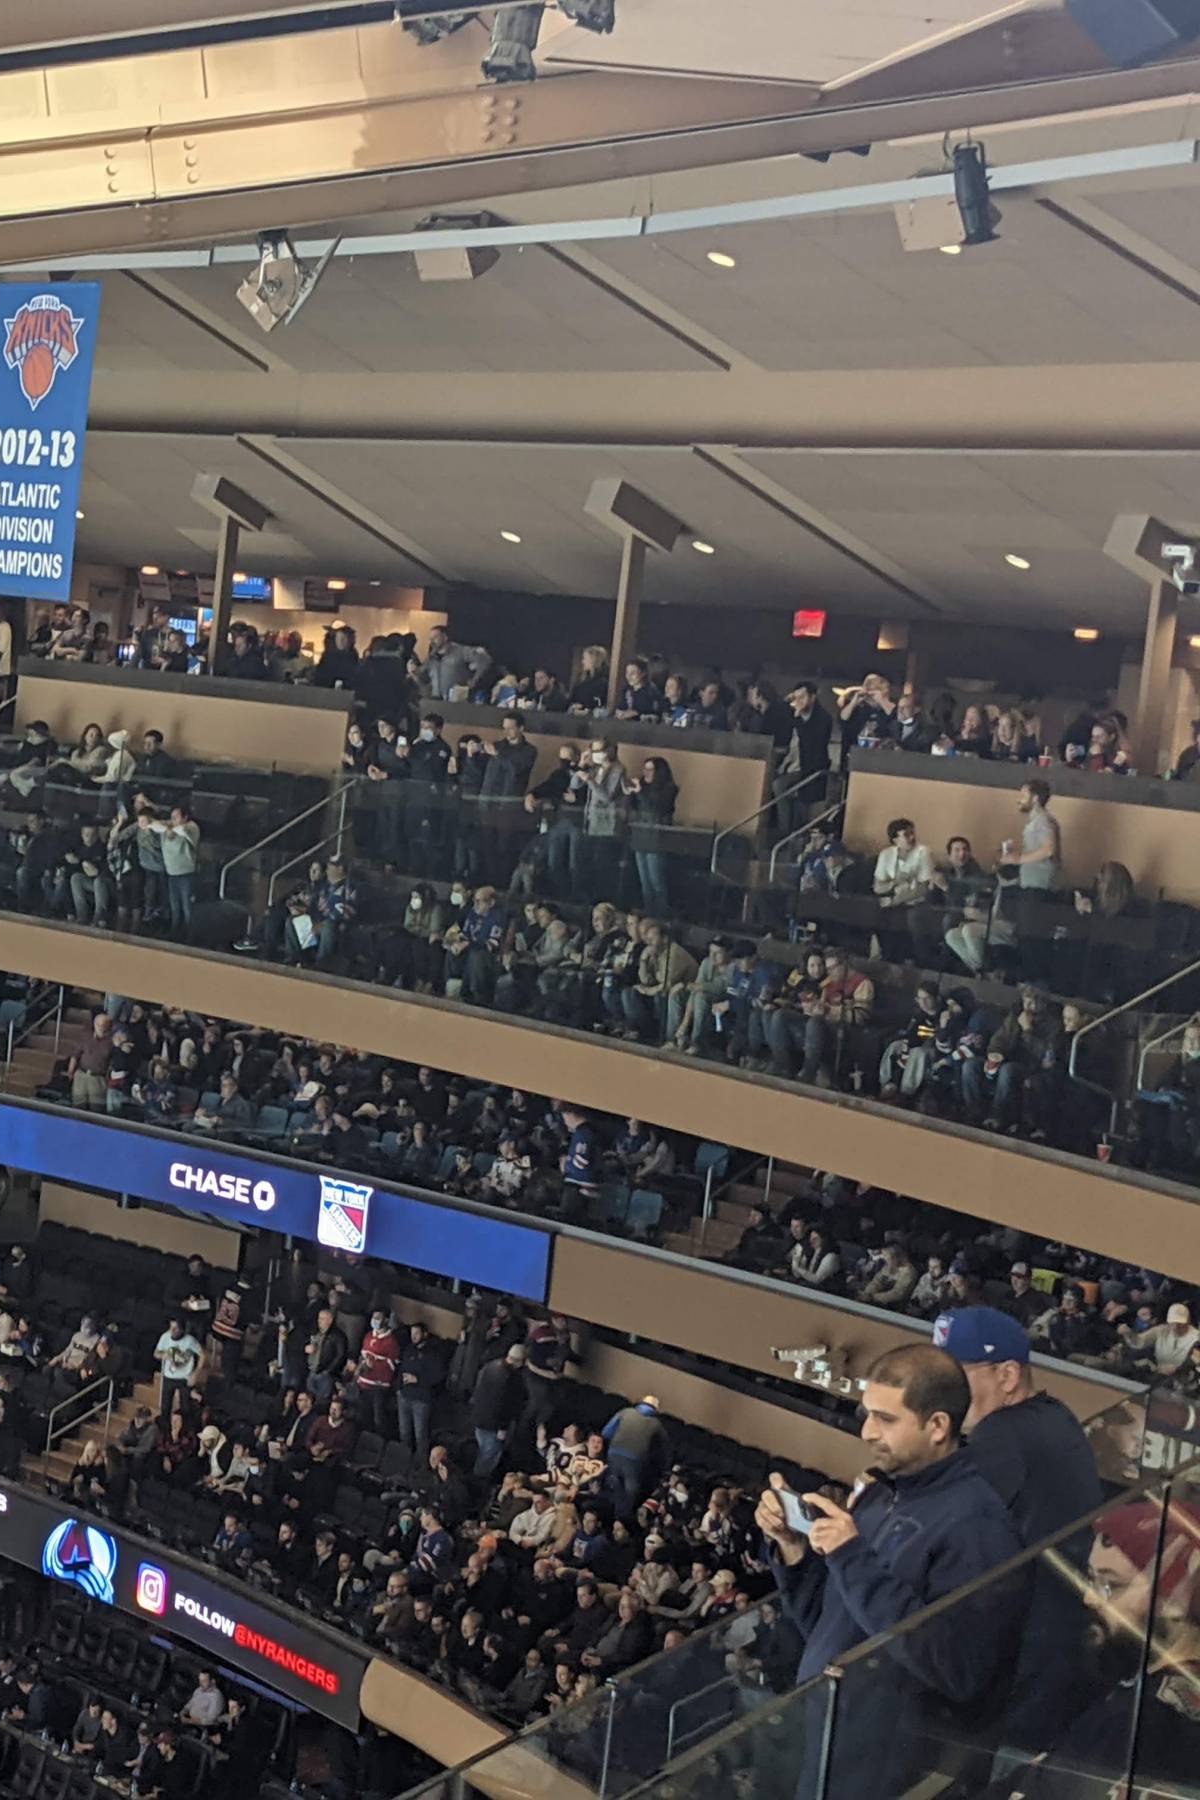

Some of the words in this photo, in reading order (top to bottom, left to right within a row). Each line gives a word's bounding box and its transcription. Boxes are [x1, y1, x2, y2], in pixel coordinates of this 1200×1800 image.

[169, 1162, 252, 1204] CHASE
[174, 1593, 235, 1638] FOLLOW
[234, 1623, 338, 1695] @NYRANGERS
